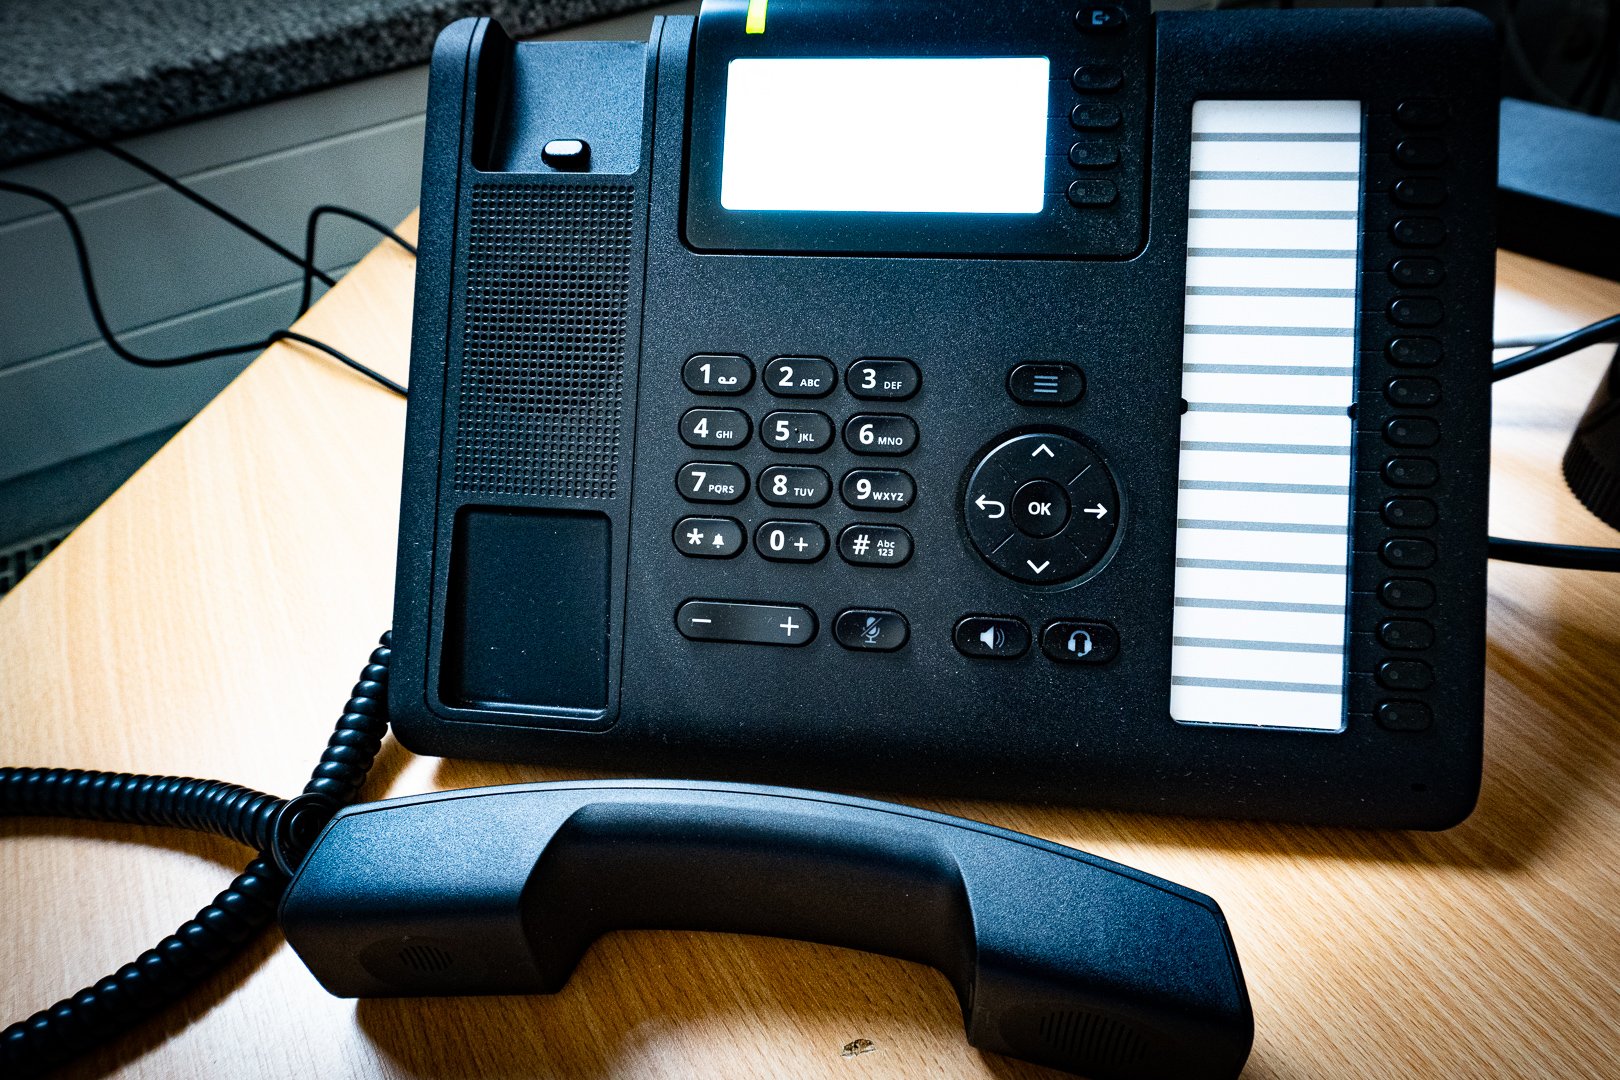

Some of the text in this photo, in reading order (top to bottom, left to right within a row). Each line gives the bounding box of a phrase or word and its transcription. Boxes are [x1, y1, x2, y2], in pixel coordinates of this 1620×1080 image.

[699, 363, 711, 384] 1
[778, 365, 821, 388] 2 ABC
[861, 368, 903, 390] 3 DEF
[693, 417, 733, 439] 4 GHI
[775, 420, 815, 444] 5 JKL
[859, 423, 903, 446] 6 MNO
[691, 471, 735, 495] 7 PQRS
[772, 474, 815, 497] 8 TUV
[856, 478, 904, 502] 9 WXYZ
[1027, 501, 1052, 516] OK
[769, 529, 785, 551] 0
[876, 539, 896, 548] Abc
[877, 549, 894, 557] 123
